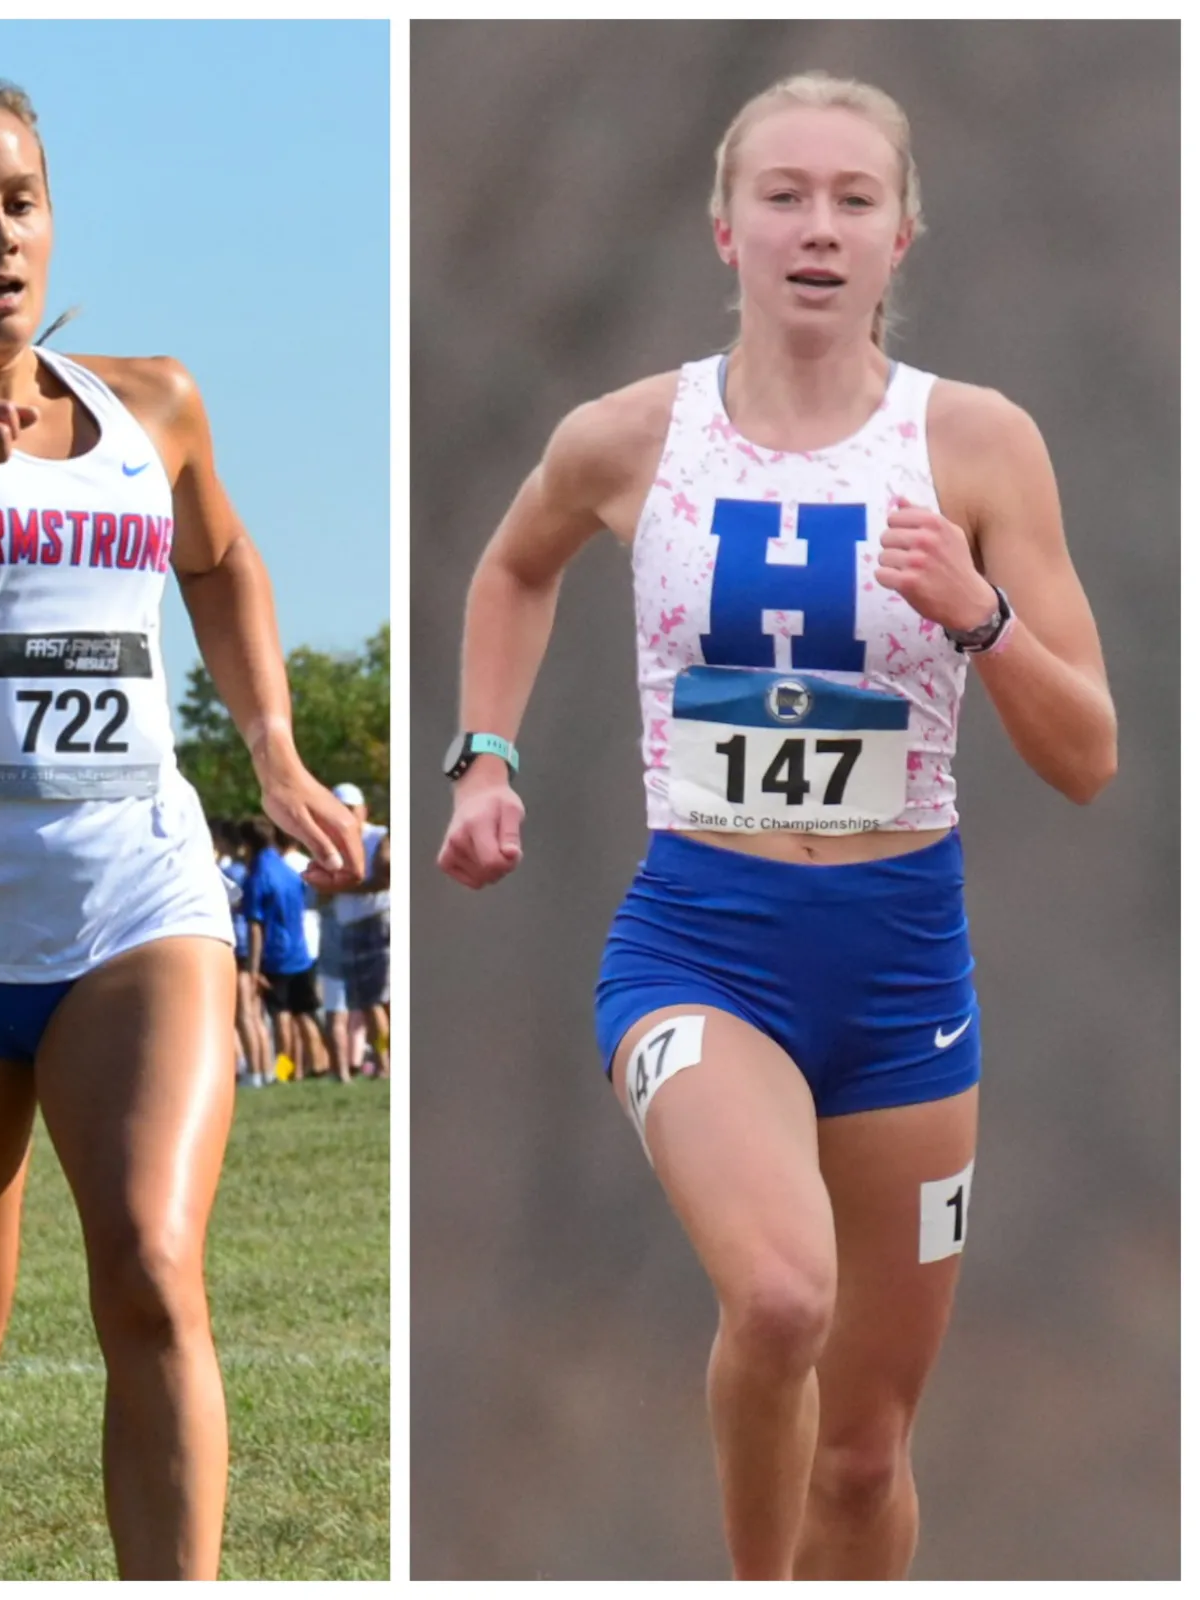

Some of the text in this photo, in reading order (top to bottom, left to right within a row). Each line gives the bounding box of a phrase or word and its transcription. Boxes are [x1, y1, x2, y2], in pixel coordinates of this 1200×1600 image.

[699, 497, 867, 672] H
[15, 689, 130, 754] 722
[715, 734, 864, 806] 147
[689, 811, 881, 832] State CC Championships
